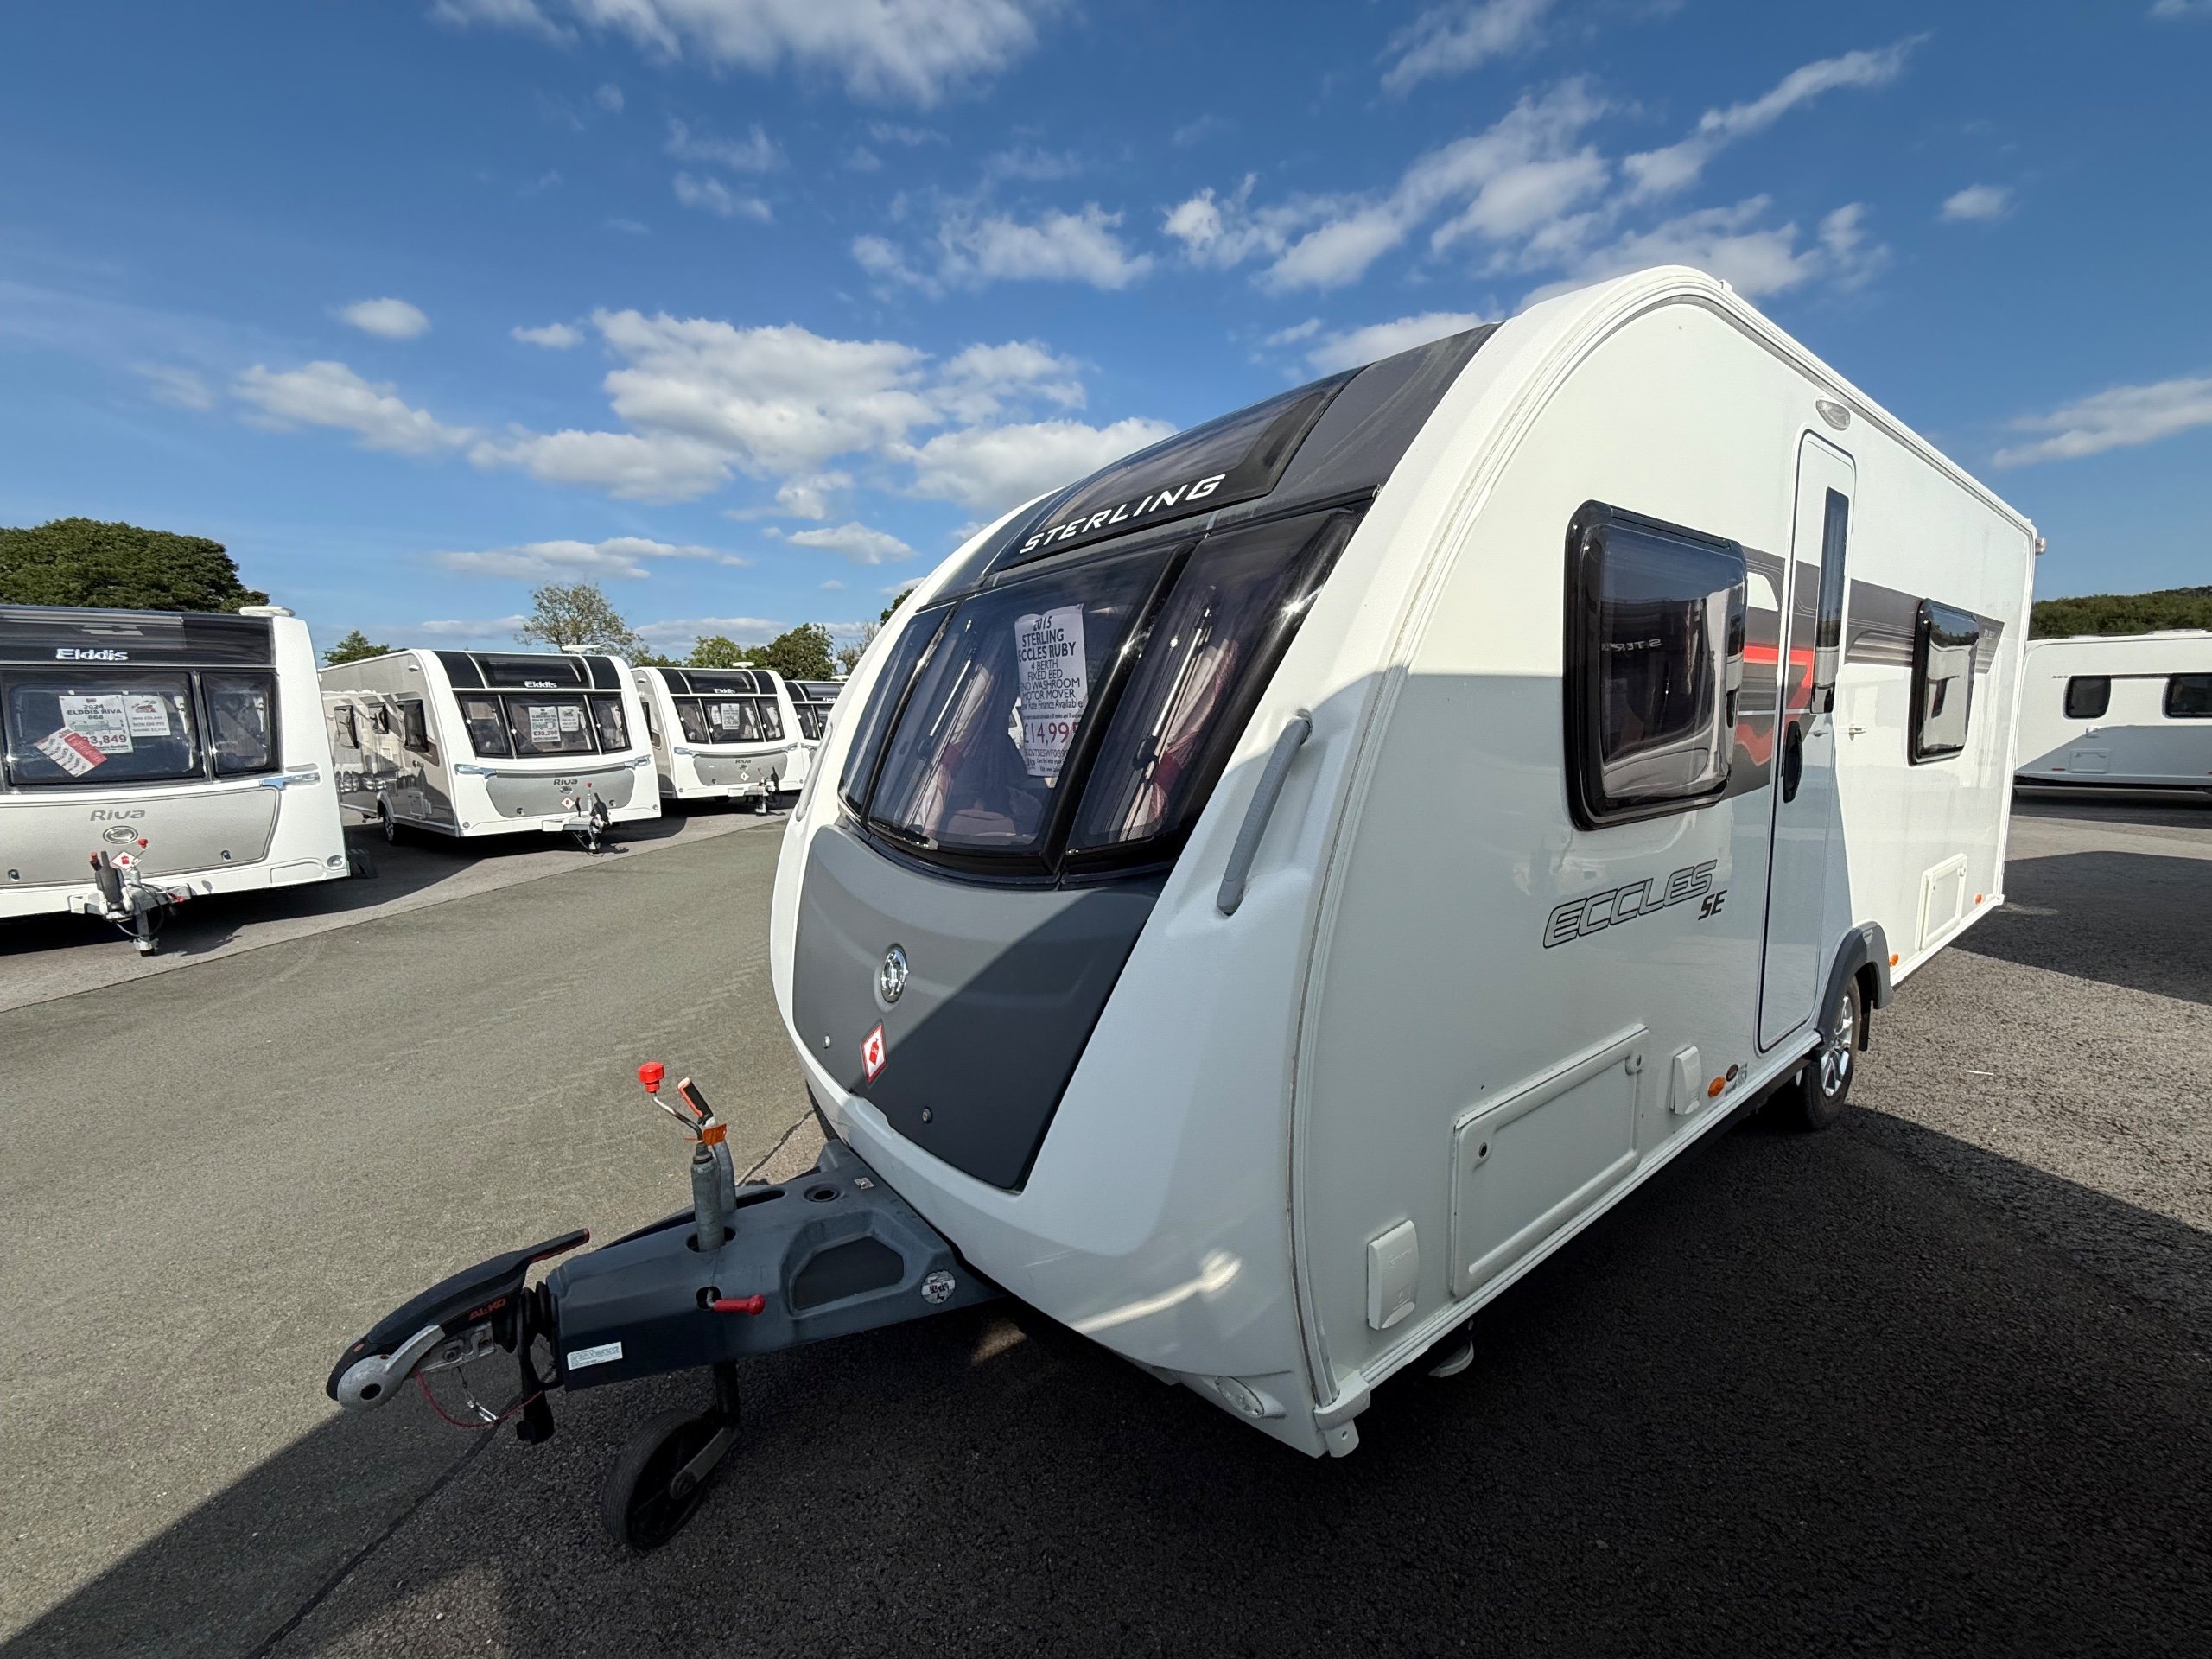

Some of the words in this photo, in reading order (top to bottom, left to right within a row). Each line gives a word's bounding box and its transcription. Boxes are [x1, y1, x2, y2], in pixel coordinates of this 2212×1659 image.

[1020, 474, 1225, 554] STERLING
[1033, 615, 1052, 631] 2015
[1022, 628, 1064, 647] STERLING
[55, 648, 130, 661] Elddis
[1018, 645, 1047, 663] ECCLES
[1048, 641, 1076, 658] RUBY
[1031, 662, 1035, 671] 4
[1036, 658, 1058, 671] BERTH
[1027, 670, 1047, 681] FIXED
[1048, 669, 1064, 680] BED
[1032, 677, 1081, 690] WASHROOM
[1022, 691, 1045, 702] MOTOR
[1046, 689, 1076, 700] MOVER
[1055, 697, 1084, 709] Available
[90, 809, 146, 821] Riva
[1542, 859, 1718, 949] ECCLES
[1698, 889, 1727, 920] SE
